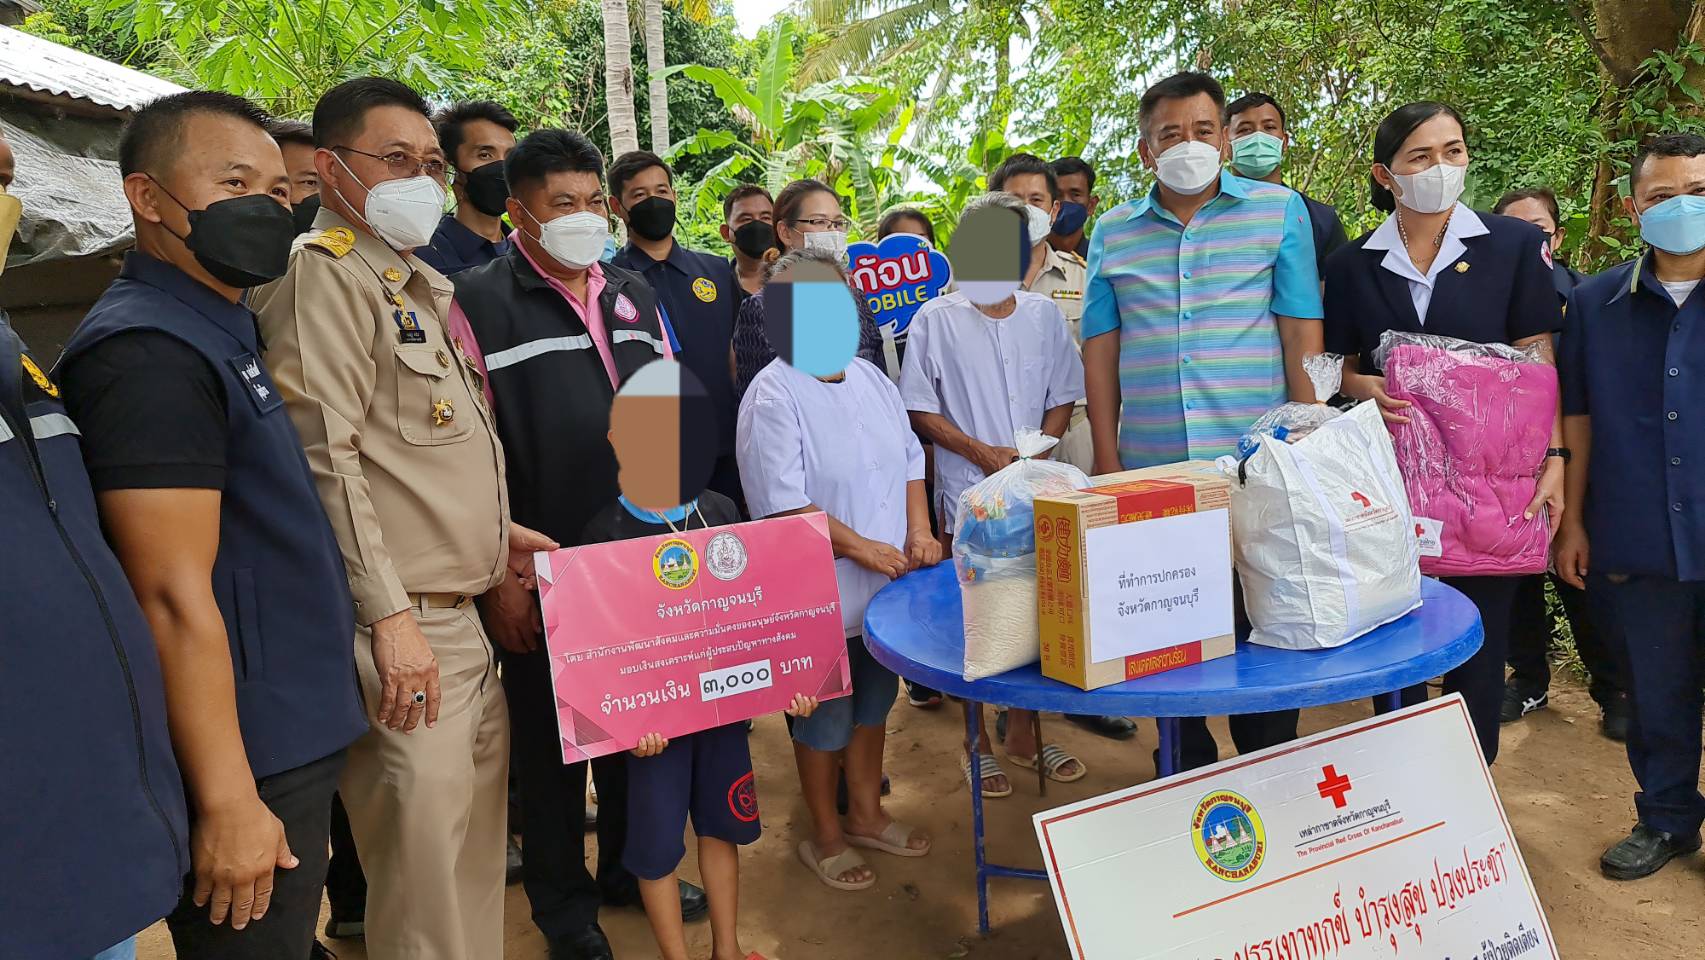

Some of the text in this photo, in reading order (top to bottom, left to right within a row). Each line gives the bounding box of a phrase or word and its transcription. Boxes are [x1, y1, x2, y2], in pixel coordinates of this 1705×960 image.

[867, 285, 929, 314] OBILE
[1118, 567, 1196, 590] ที่ทำการปกครอง
[656, 585, 763, 618] จังหวัดกาญจนบุรี
[1117, 587, 1199, 617] จังหวัดกาญจนบุรี
[564, 651, 583, 664] โดย
[619, 631, 797, 675] มอบเงินสงเคราะห์แก่ผู้ประสบปัญหาทางสังคม
[600, 655, 813, 715] จำนวนเงิน ๓,๐๐๐ บาท
[1299, 799, 1391, 838] เหล่ากาชาดจังหวัดกาญจนบุรี
[1206, 841, 1264, 878] KANCHANABURI
[1297, 850, 1308, 858] The
[1308, 841, 1335, 855] Provincial
[1335, 836, 1346, 845] Red
[1347, 832, 1362, 841] Cross
[1234, 881, 1351, 960] รรเทาทกข์
[1355, 878, 1427, 955] บำรุงสุข
[1481, 921, 1540, 960] ผ้ป่วยติดเตียง
